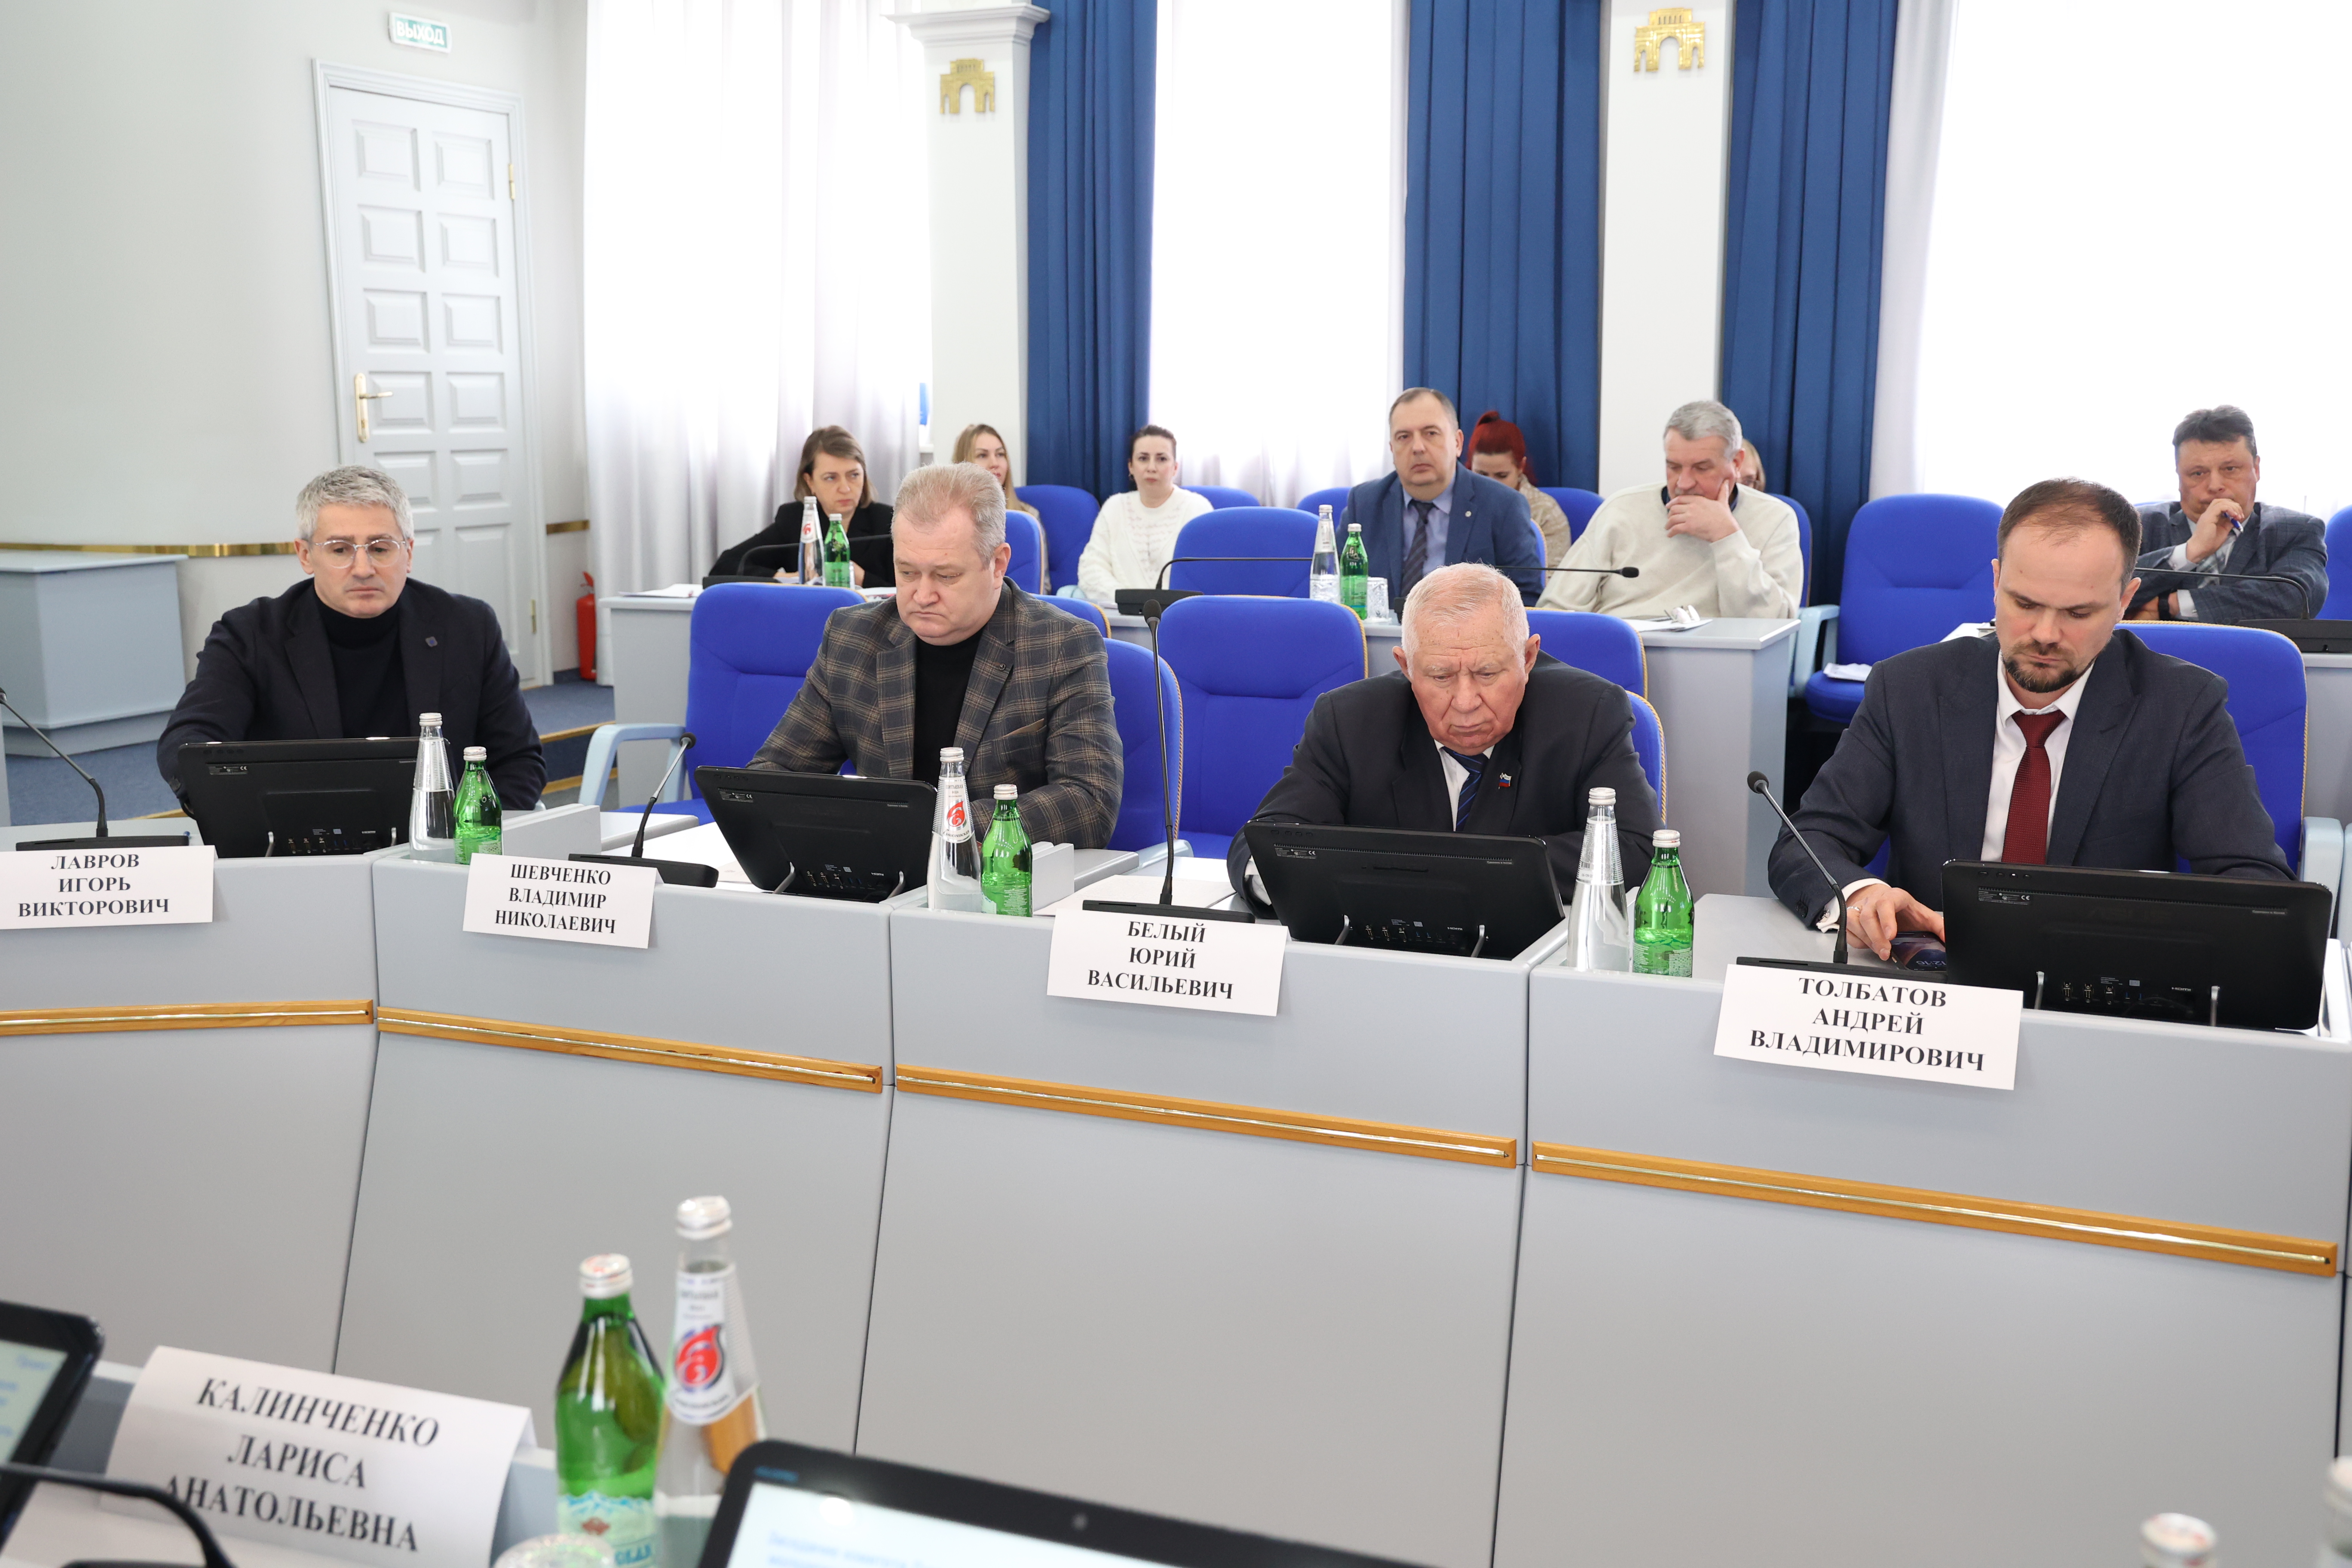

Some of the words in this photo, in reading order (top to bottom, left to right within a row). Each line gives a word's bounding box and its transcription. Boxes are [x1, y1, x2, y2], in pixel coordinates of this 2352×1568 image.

[396, 21, 444, 45] ВЫХОД
[51, 854, 139, 870] ЛАВРОВ
[58, 877, 131, 893] ИГОРЬ
[510, 864, 610, 885] ШЕВЧЕНКО
[18, 899, 170, 917] ВИКТОРОВИЧ
[508, 888, 606, 909] ВЛАДИМИР
[495, 910, 616, 934] НИКОЛАЕВИЧ
[1127, 921, 1207, 943] БЕЛЫЙ
[1129, 947, 1197, 969] ЮРИЙ
[1087, 970, 1234, 999] ВАСИЛЬЕВИЧ
[1798, 977, 1947, 1007] ТОЛБАТОВ
[1812, 1008, 1925, 1035] АНДРЕЙ
[1749, 1030, 1986, 1071] ВЛАДИМИРОВИЧ
[196, 1378, 440, 1447] КАЛИНЧЕНКО
[227, 1435, 366, 1488] ЛАРИСА
